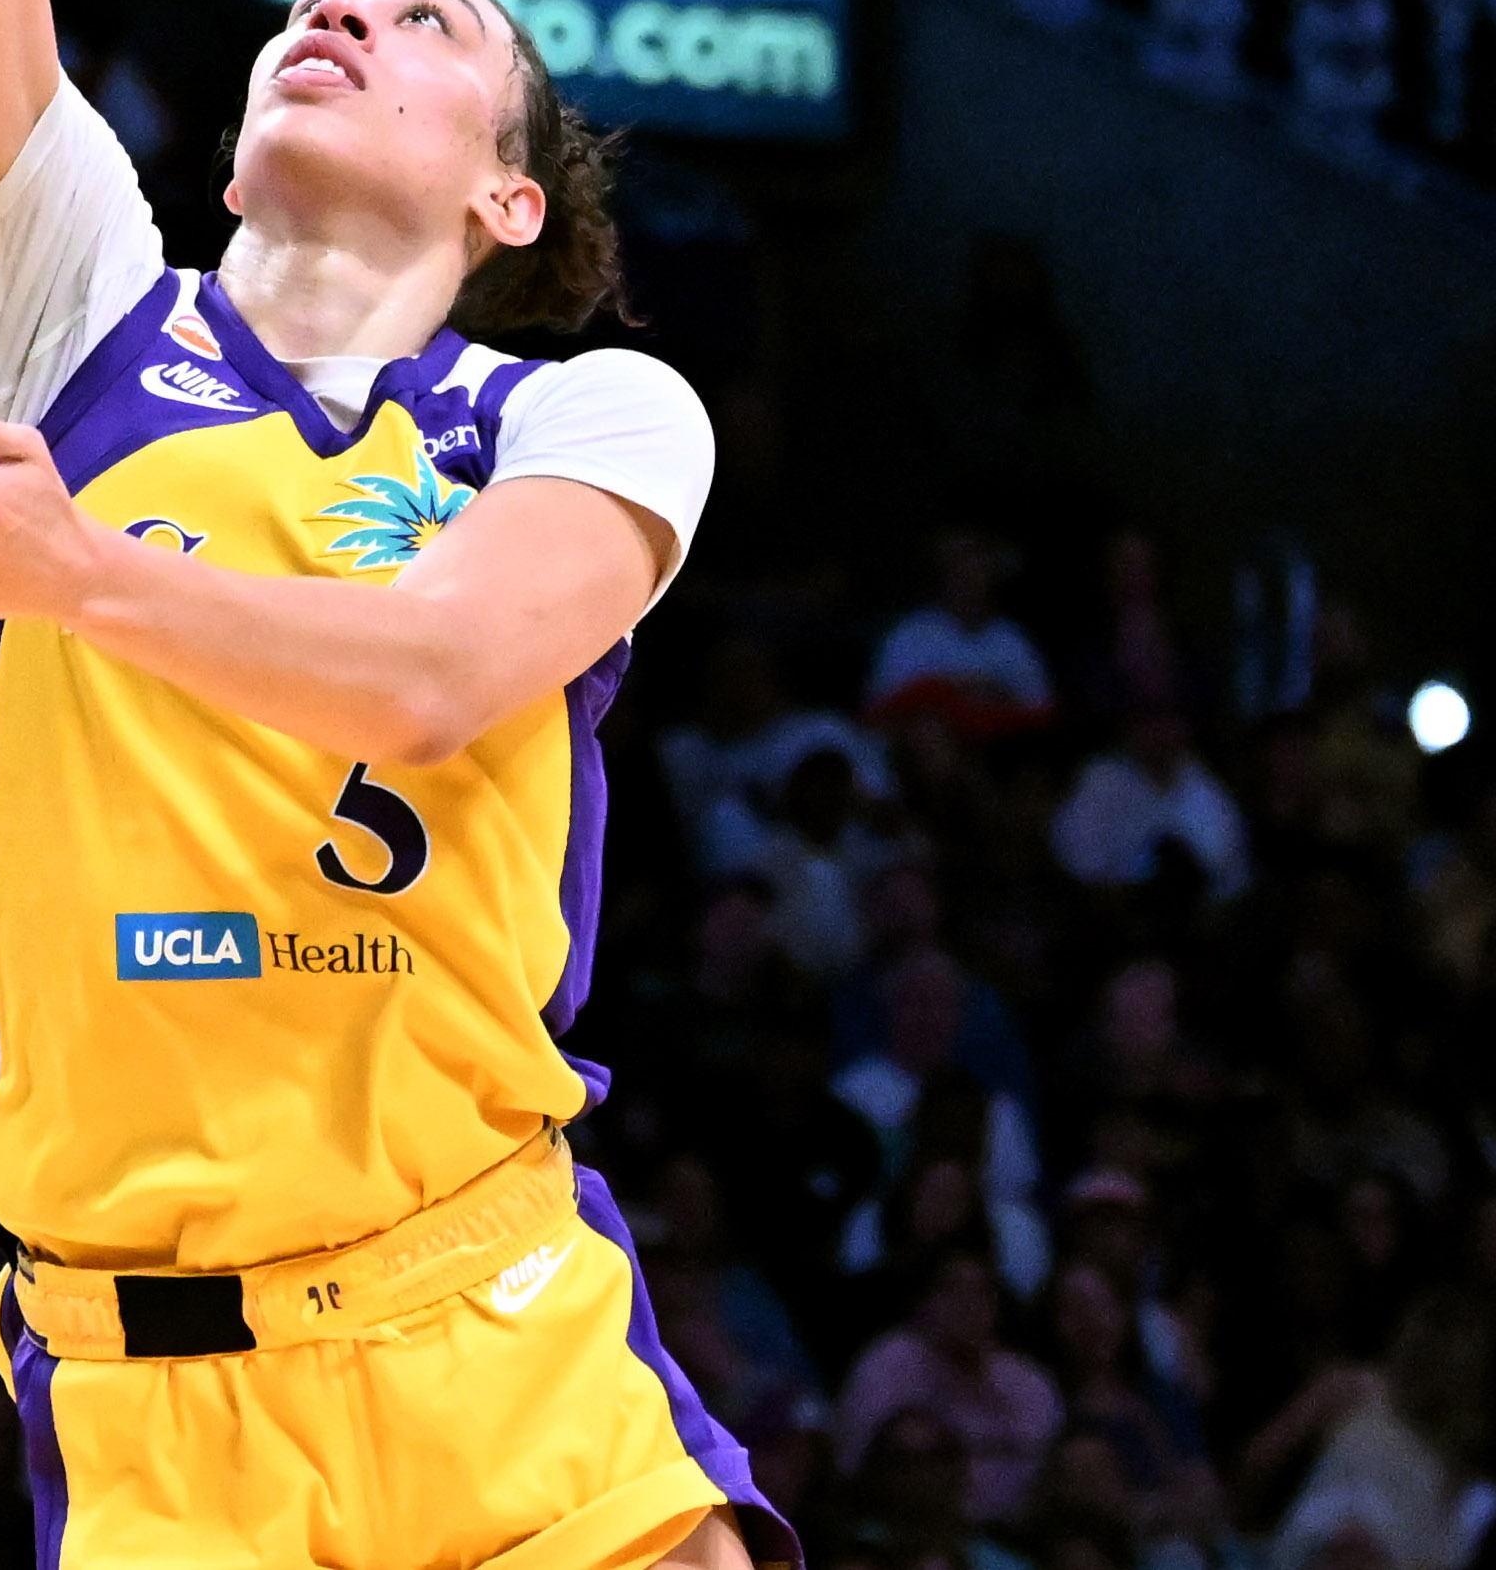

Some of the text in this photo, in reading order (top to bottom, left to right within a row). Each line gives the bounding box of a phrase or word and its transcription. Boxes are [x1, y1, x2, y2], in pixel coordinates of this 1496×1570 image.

[162, 360, 241, 401] NIKE
[314, 761, 431, 897] 5
[134, 929, 415, 975] UCLA Health
[500, 1244, 554, 1294] NIKE
